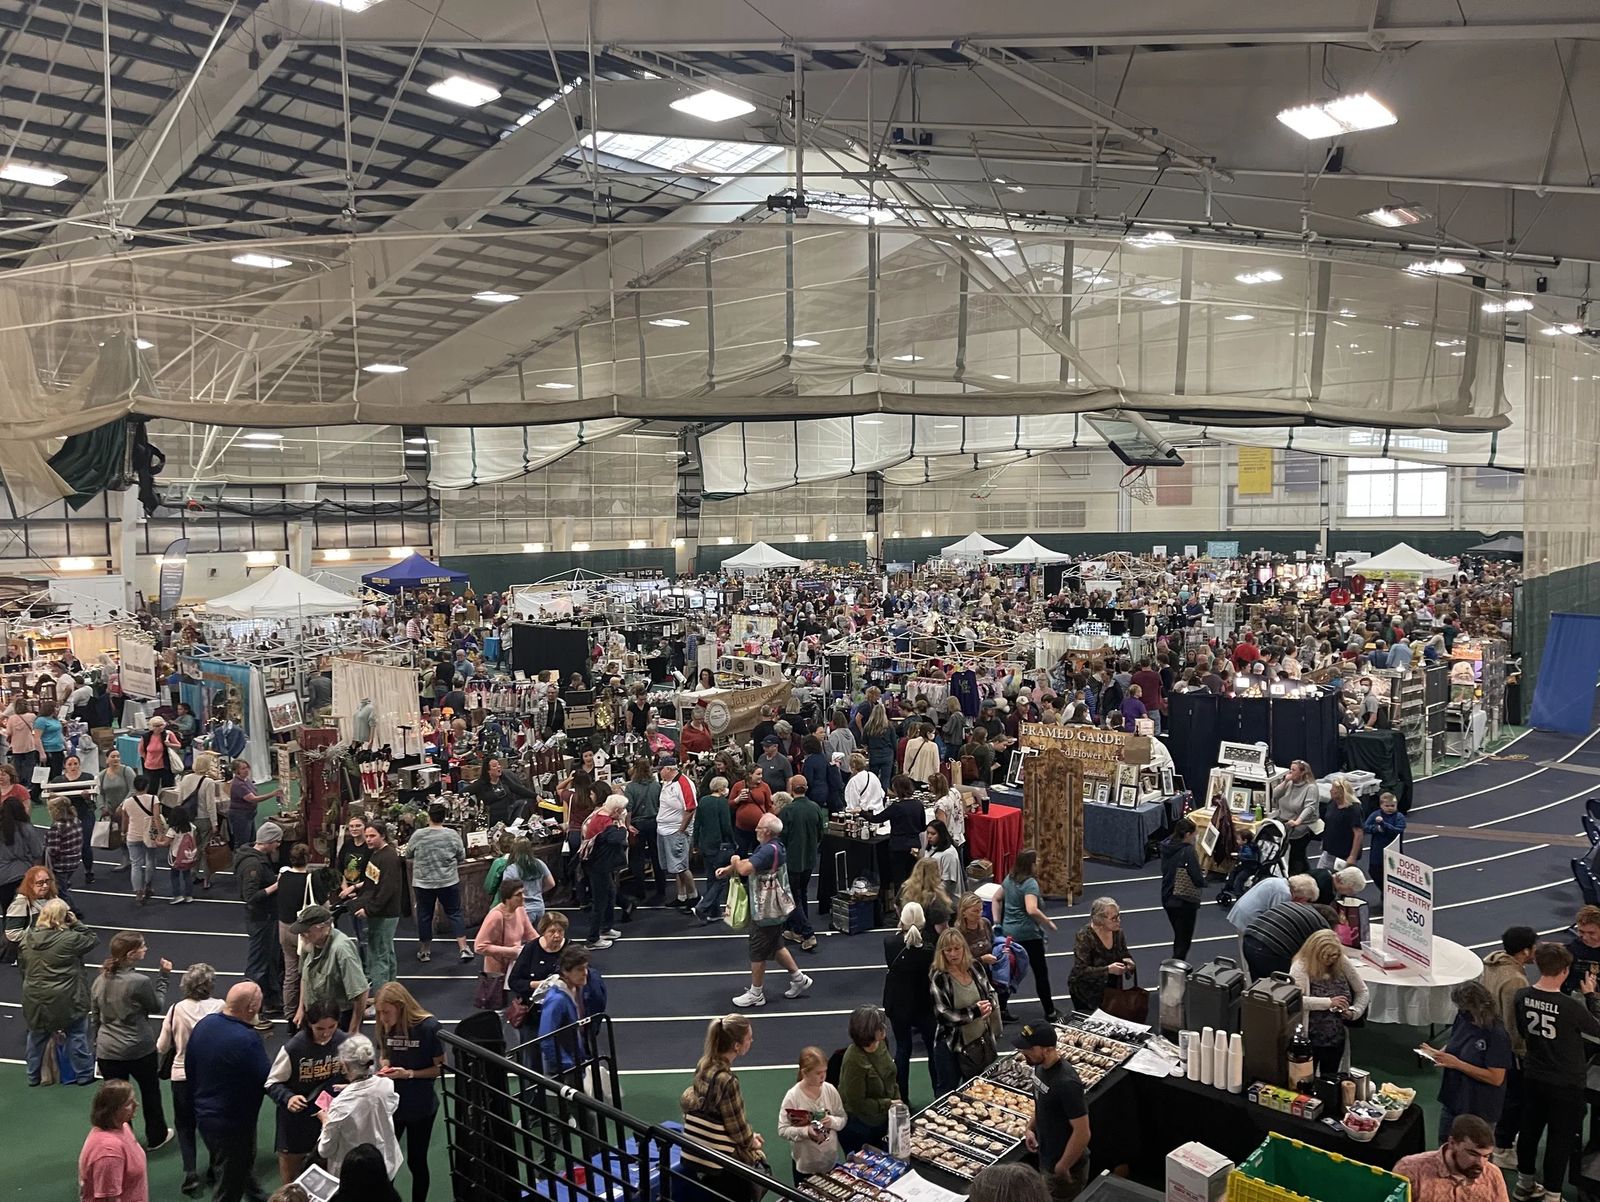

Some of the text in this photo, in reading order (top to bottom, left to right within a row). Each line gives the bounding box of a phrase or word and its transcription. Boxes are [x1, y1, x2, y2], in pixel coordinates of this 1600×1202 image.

[1021, 724, 1125, 746] FRAMED GARDE
[1073, 748, 1101, 760] Flower
[1103, 752, 1119, 762] Art
[1399, 858, 1421, 874] DOOR
[1396, 867, 1424, 886] RAFFLE
[1387, 885, 1407, 900] FREE
[1407, 893, 1431, 911] ENTRY
[1406, 907, 1425, 927] $50
[1524, 996, 1559, 1015] HANSELL
[1526, 1010, 1557, 1040] 25
